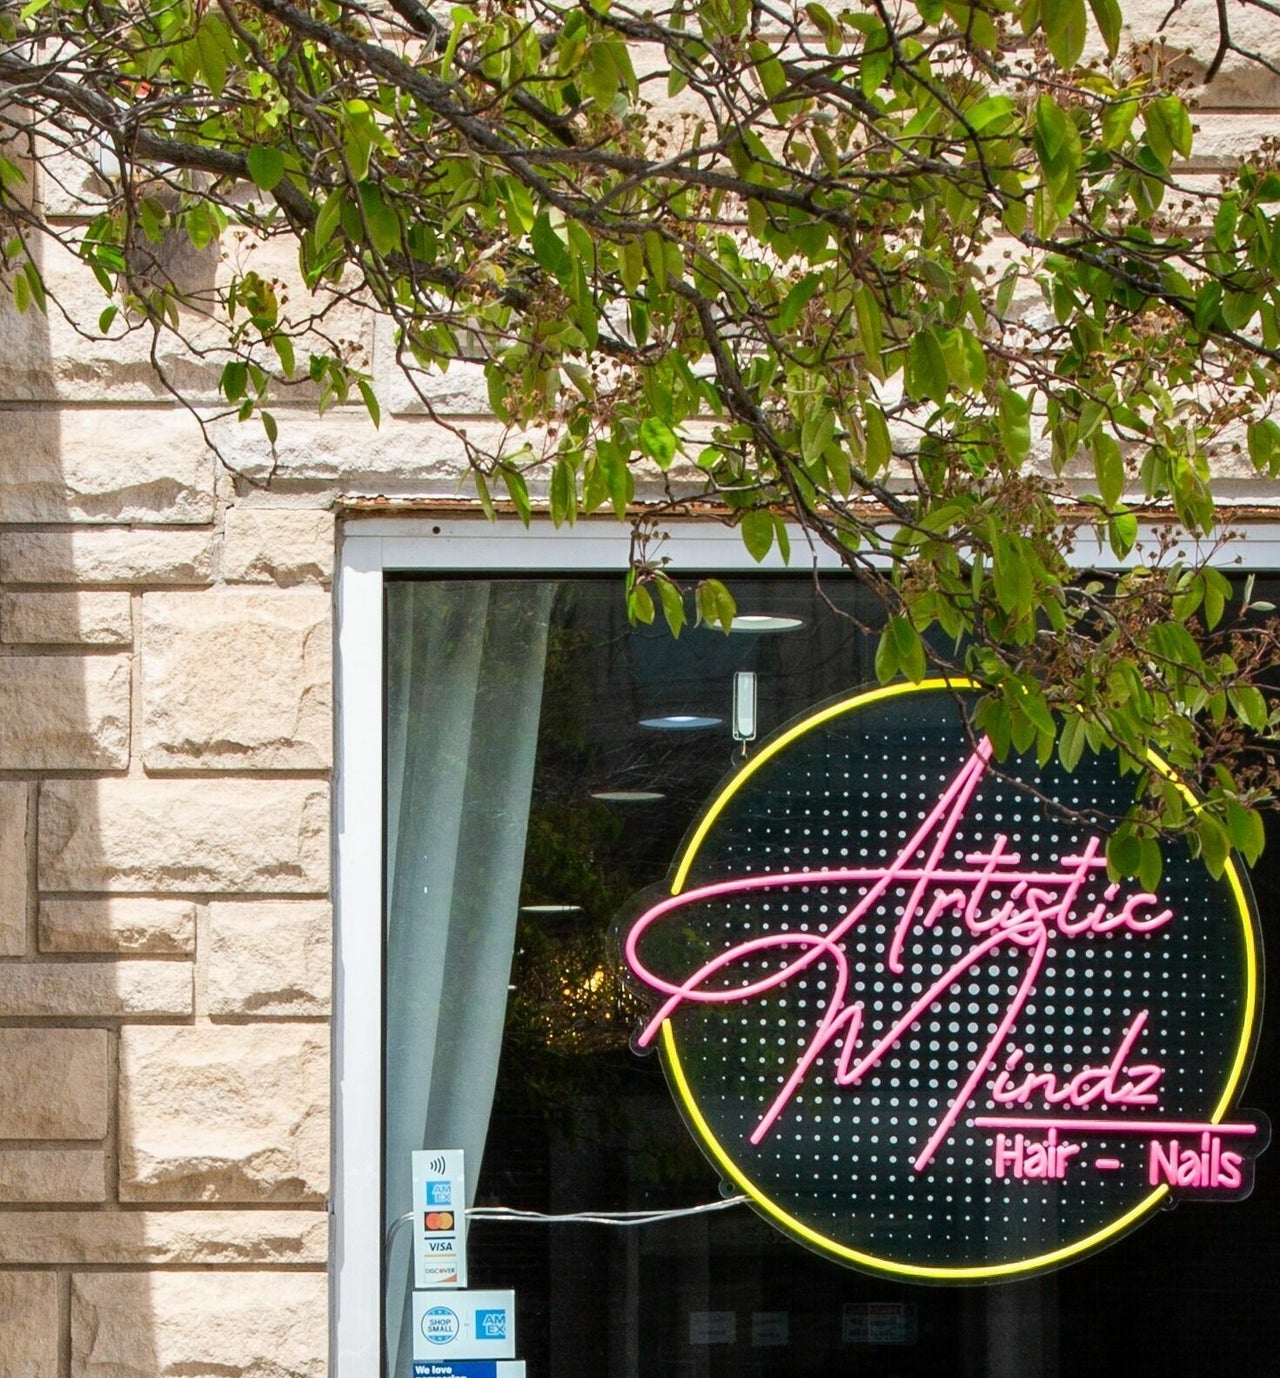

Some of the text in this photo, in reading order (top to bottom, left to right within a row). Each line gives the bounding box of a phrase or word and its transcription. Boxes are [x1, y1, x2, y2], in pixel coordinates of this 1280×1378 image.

[625, 735, 1175, 1001] Artistic
[995, 1127, 1081, 1179] Hair
[1148, 1131, 1243, 1188] Nails
[429, 1242, 453, 1251] VISA
[415, 1365, 452, 1374] We love
